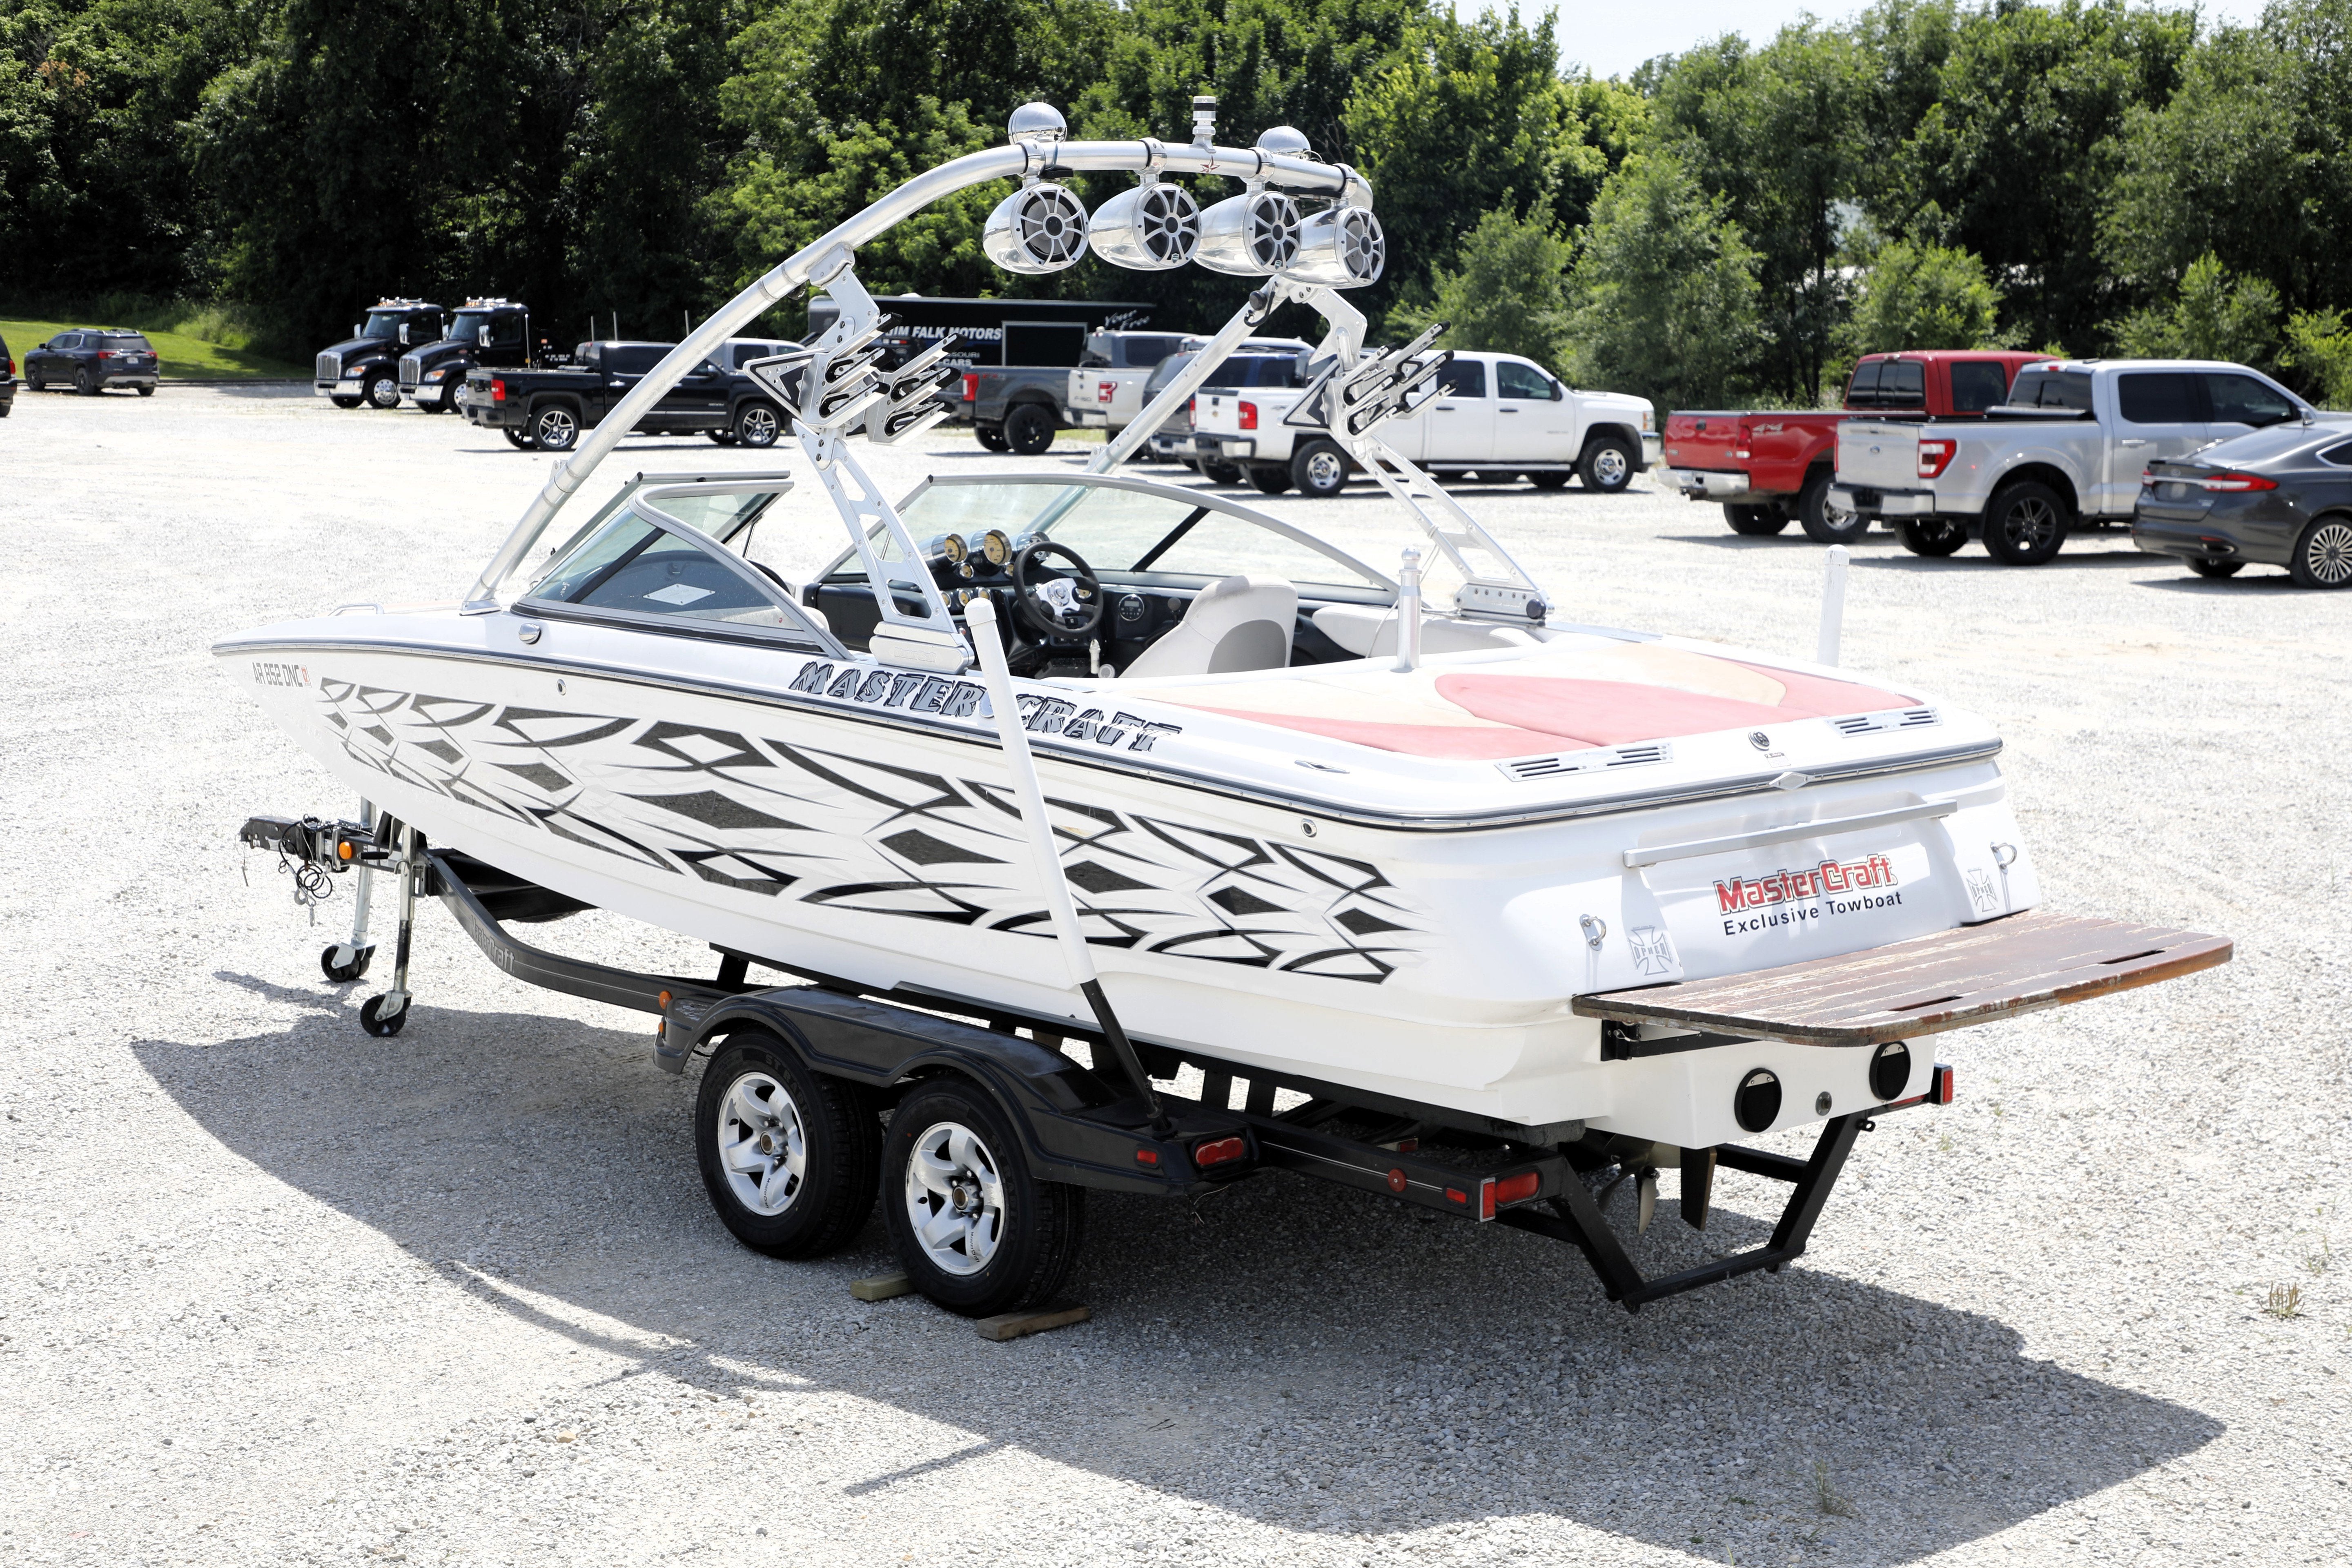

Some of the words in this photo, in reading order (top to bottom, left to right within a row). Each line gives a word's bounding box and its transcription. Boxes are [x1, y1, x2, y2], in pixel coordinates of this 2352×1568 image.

[885, 325, 910, 337] JIM
[911, 326, 946, 339] FALK
[948, 327, 1002, 340] MOTORS
[1105, 309, 1137, 327] Your
[1120, 316, 1150, 331] Free
[252, 662, 266, 684] AR
[263, 663, 283, 686] 852
[281, 664, 303, 687] DNC
[788, 661, 987, 717] MASTER
[1016, 693, 1183, 752] CRAFT
[1713, 854, 1898, 915] MasterCraft
[1724, 906, 1819, 935] Exclusive
[1826, 891, 1902, 915] Towboat
[471, 915, 515, 973] MasterCraft
[763, 1178, 771, 1209] MasterCraft
[970, 1232, 980, 1263] MasterCraft
